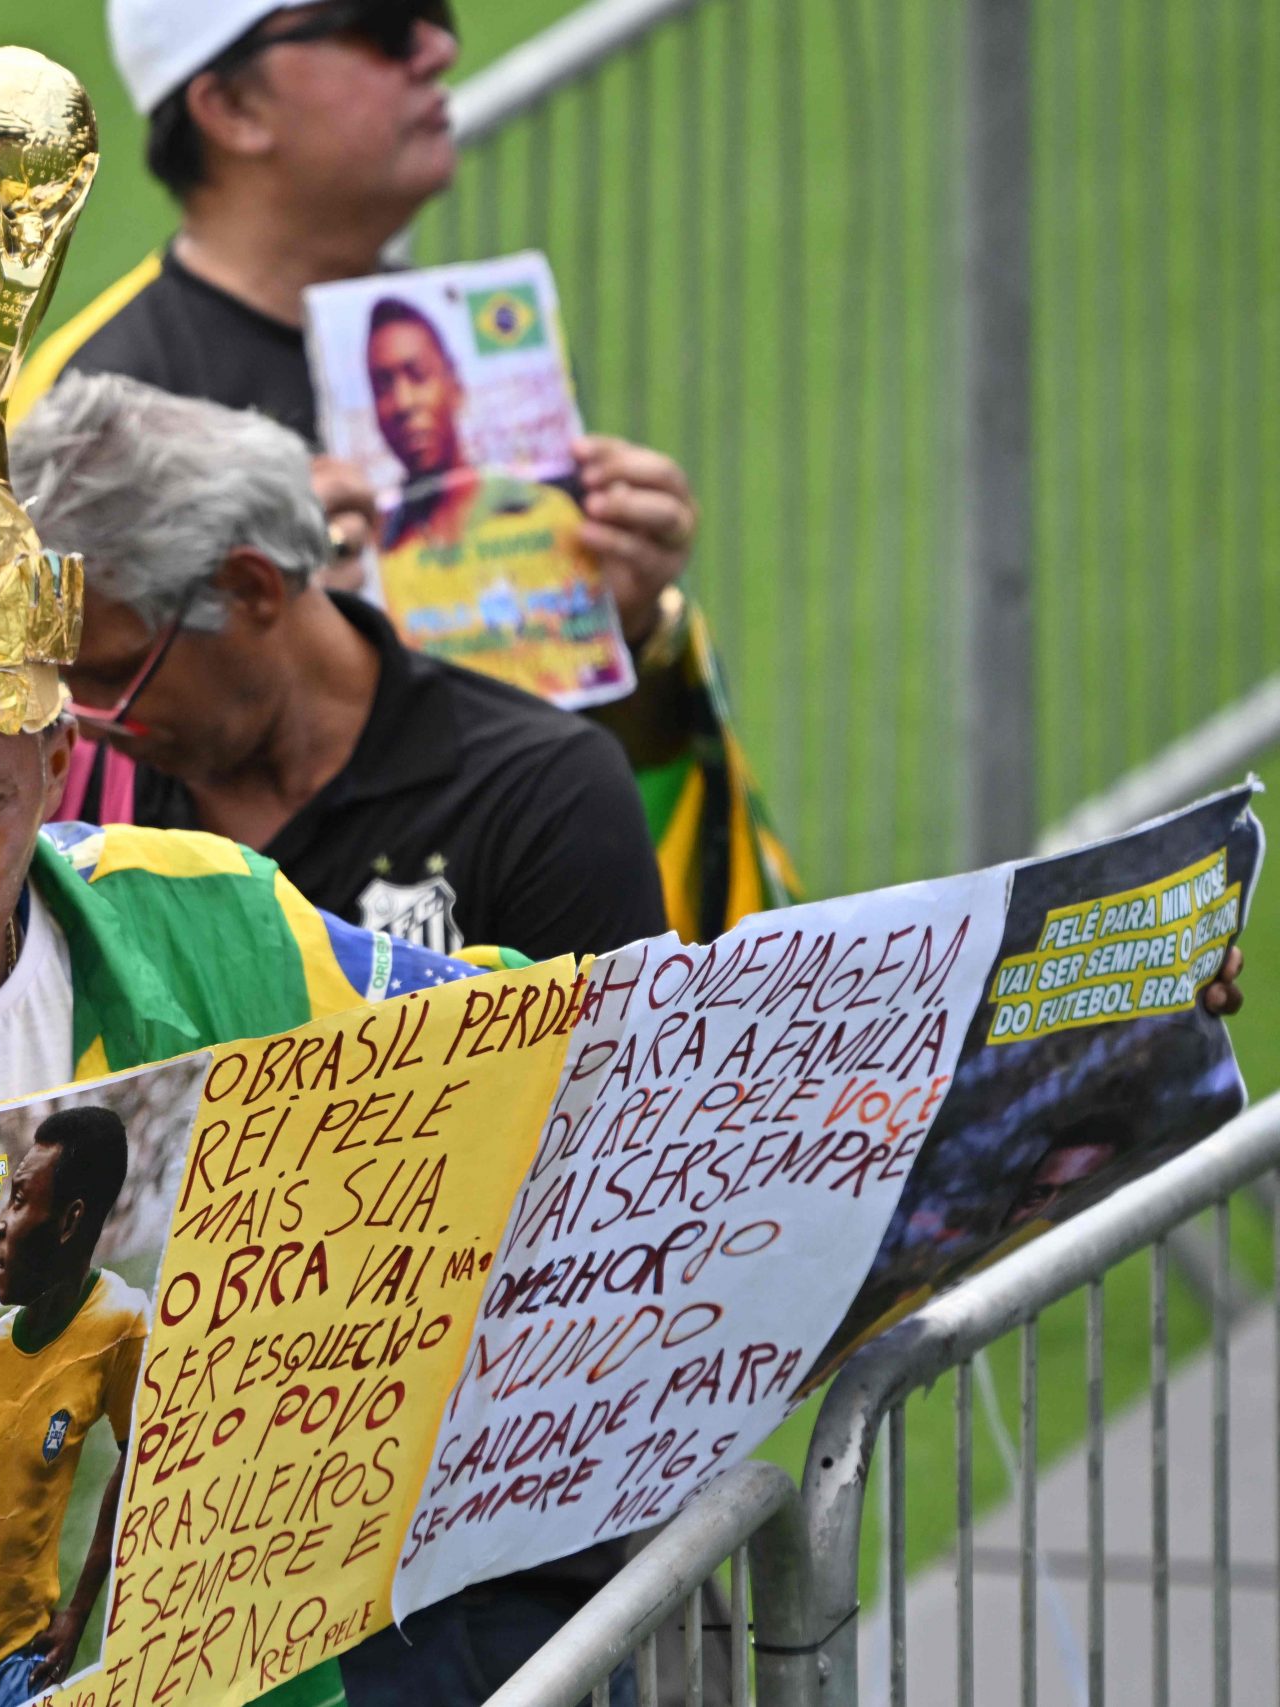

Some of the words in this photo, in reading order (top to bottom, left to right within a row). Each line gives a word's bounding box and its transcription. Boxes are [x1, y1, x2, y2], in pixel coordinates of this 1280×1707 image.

[996, 962, 1035, 996] VAI
[1037, 953, 1084, 991] SER
[1084, 933, 1176, 978] SEMPRE
[1180, 927, 1192, 961] O
[1039, 904, 1101, 951] PELÉ
[1100, 897, 1155, 938] PARA
[992, 1003, 1031, 1036] DO
[1034, 981, 1133, 1031] FUTEBOL
[555, 1012, 706, 1111] PARA
[180, 1095, 299, 1212] REI
[297, 1081, 469, 1170] PELE
[174, 1172, 309, 1244] MAIS
[346, 1245, 433, 1309] VAI
[140, 1336, 235, 1428] SER
[449, 1303, 722, 1421] MUNDO
[128, 1408, 245, 1502] PELO
[254, 1375, 405, 1460] POVO
[431, 1379, 649, 1497] SAUDADE
[651, 1342, 802, 1423] PARA
[115, 1437, 399, 1568] BRASILEIROS
[341, 1513, 389, 1568] E
[402, 1458, 601, 1569] SEMPRE
[259, 1641, 307, 1690] REI
[321, 1600, 375, 1655] PELE
